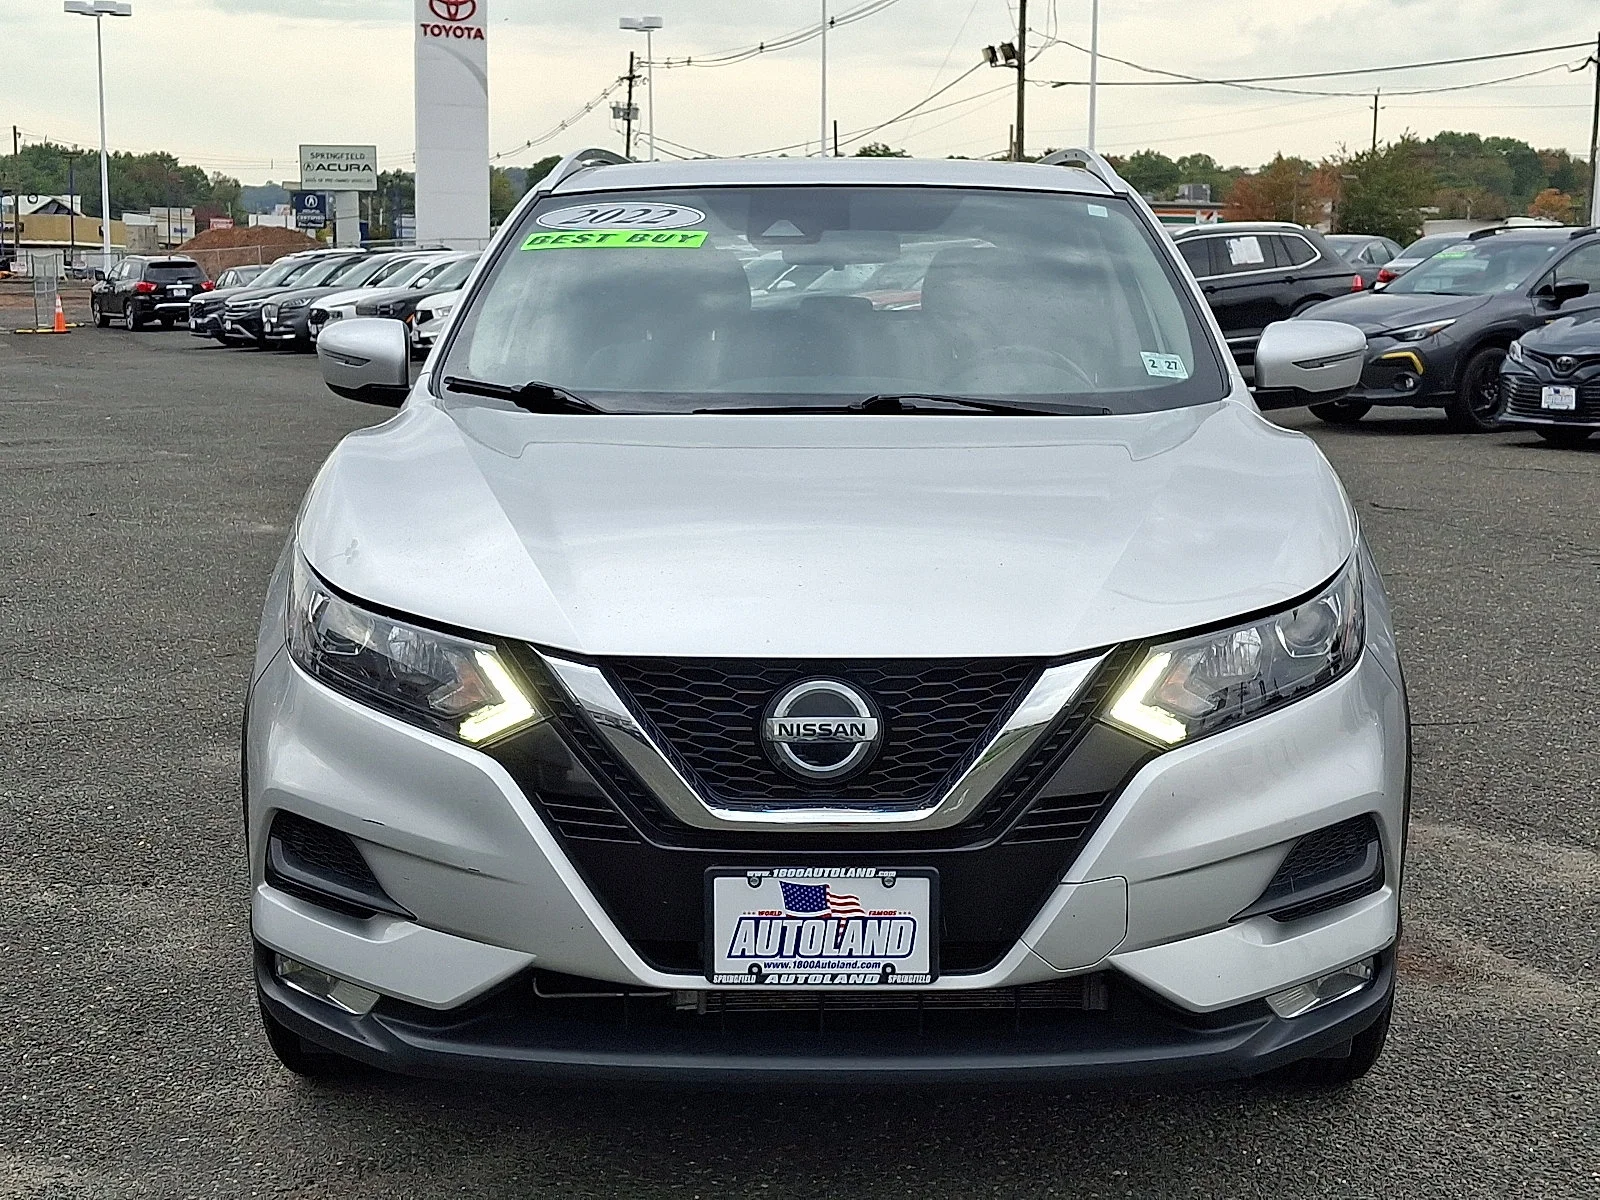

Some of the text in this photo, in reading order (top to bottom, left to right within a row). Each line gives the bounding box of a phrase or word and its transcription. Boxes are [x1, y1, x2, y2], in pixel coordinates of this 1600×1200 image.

[420, 23, 485, 40] TOYOTA
[310, 152, 365, 161] SPRINGFIELD
[316, 163, 373, 172] ACURA
[558, 208, 679, 224] 2022
[527, 233, 699, 246] BEST BUY
[1148, 359, 1178, 370] 2 27
[778, 723, 866, 737] NISSAN
[728, 917, 917, 958] AUTOLAND
[763, 960, 881, 971] www.1800Autoland.com
[713, 974, 931, 984] SPRINGFIELD AUTOLAND SPRINGFIELD
